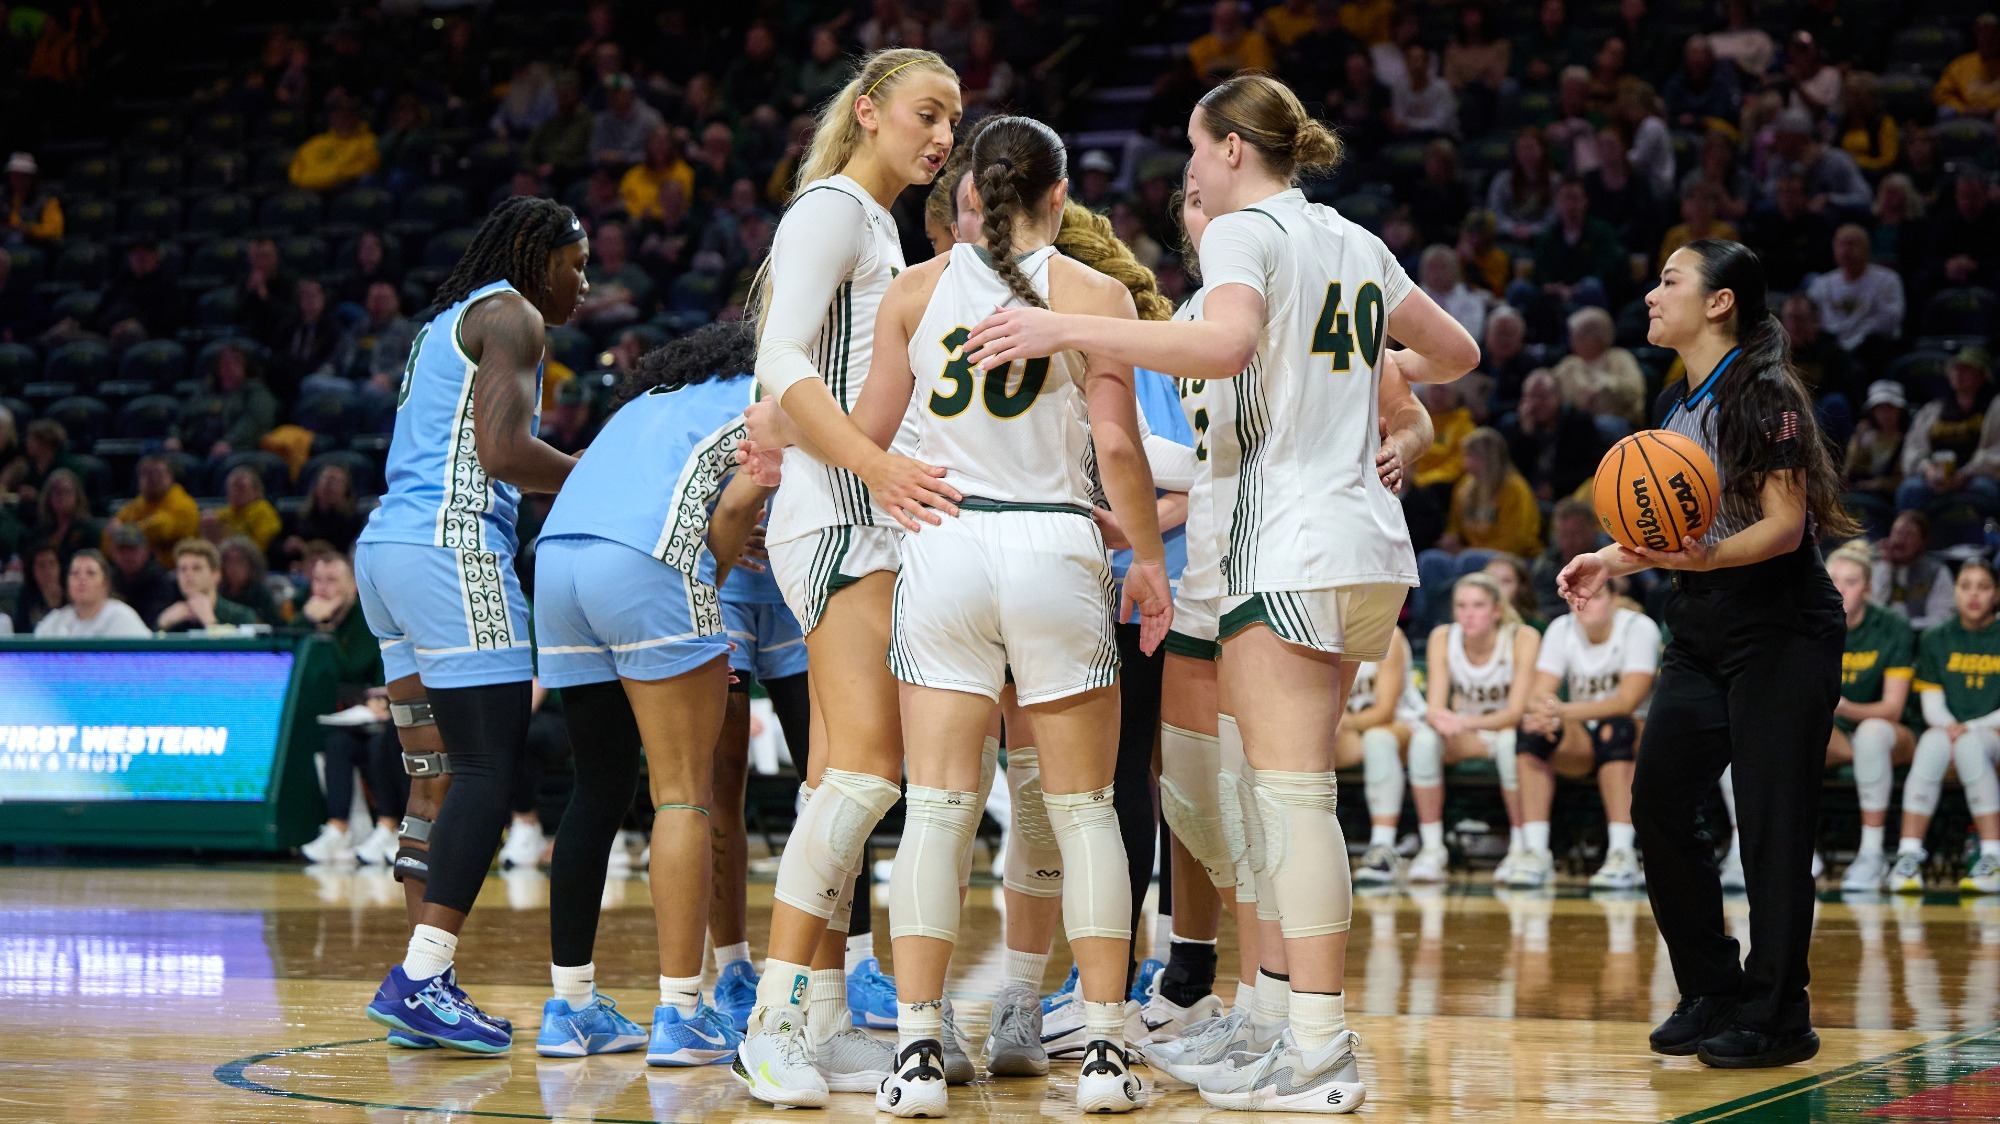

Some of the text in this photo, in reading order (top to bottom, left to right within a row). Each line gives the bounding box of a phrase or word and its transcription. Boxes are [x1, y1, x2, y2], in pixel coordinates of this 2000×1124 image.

[1310, 280, 1385, 373] 40
[927, 325, 1053, 420] 30
[1632, 475, 1670, 551] Wilson
[1667, 471, 1703, 532] NCAA
[0, 752, 40, 772] ANK
[66, 752, 133, 774] TRUST
[81, 725, 228, 756] WESTERN
